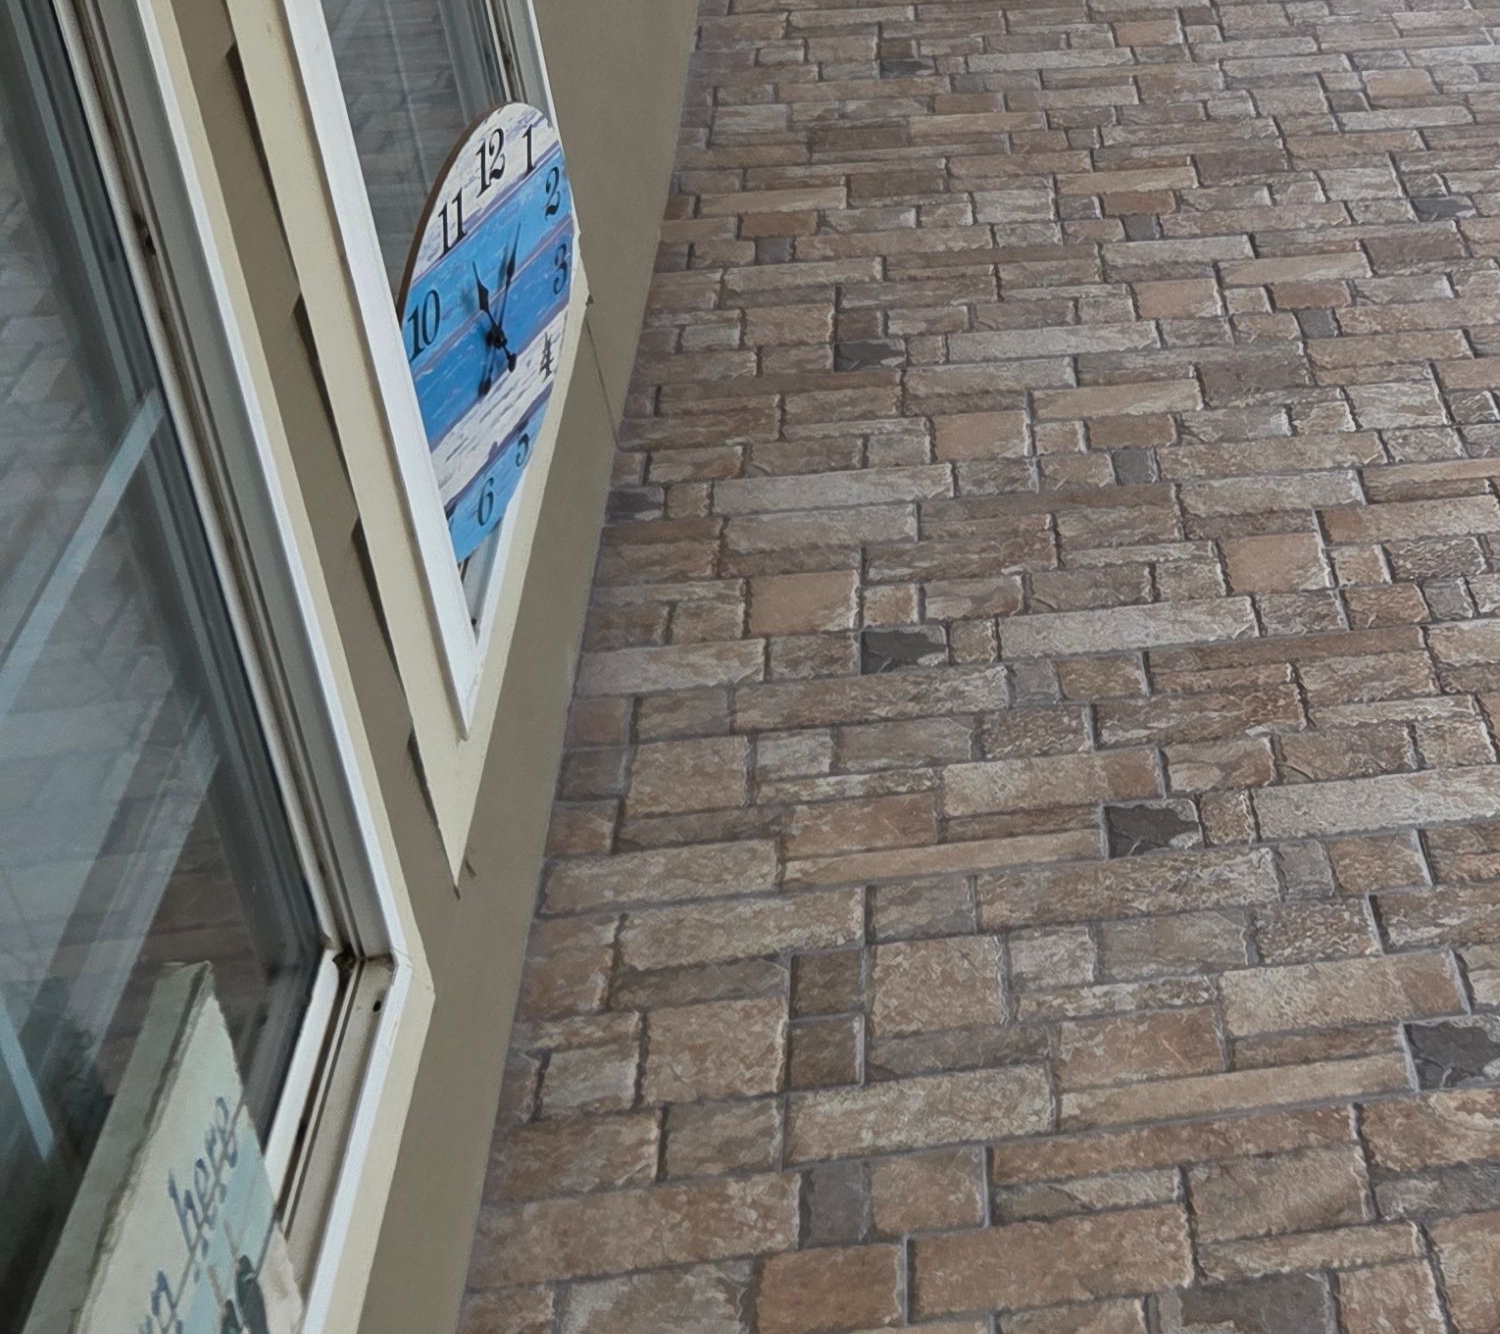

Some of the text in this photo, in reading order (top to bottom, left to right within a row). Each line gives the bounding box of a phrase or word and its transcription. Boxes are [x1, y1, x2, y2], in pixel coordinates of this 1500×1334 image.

[476, 128, 506, 198] 12
[522, 124, 536, 181] 1
[545, 166, 561, 220] 2
[438, 187, 468, 260] 11
[552, 242, 569, 296] 3
[407, 289, 441, 363] 10
[538, 331, 554, 383] 4
[477, 476, 495, 527] 6
[168, 1096, 239, 1285] here
